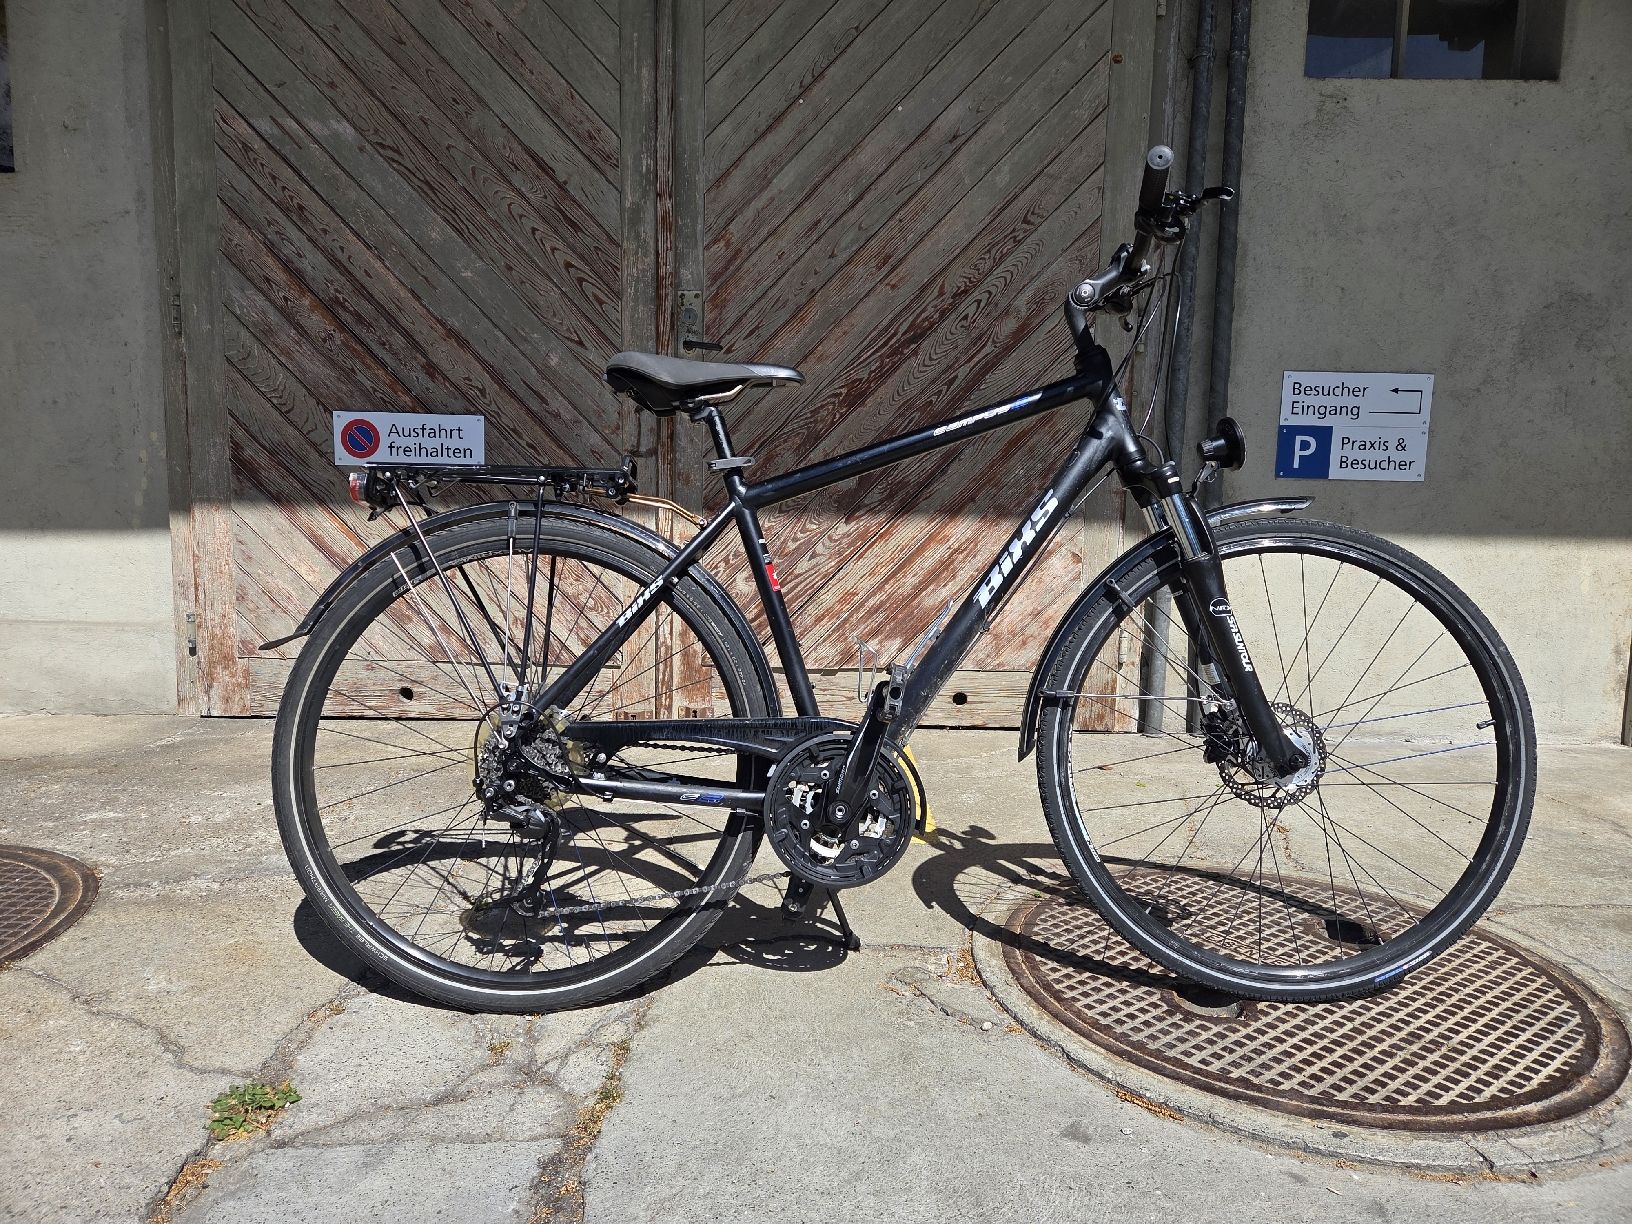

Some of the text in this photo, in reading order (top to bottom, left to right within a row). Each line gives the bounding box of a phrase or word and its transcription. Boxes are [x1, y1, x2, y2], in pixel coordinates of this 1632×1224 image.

[1292, 382, 1369, 398] Besucher
[1290, 401, 1361, 420] Eingang
[387, 423, 464, 440] Ausfahrt
[387, 441, 473, 459] freihalten
[1293, 435, 1317, 469] P
[1341, 437, 1407, 452] Praxis &
[1339, 456, 1416, 471] Besucher
